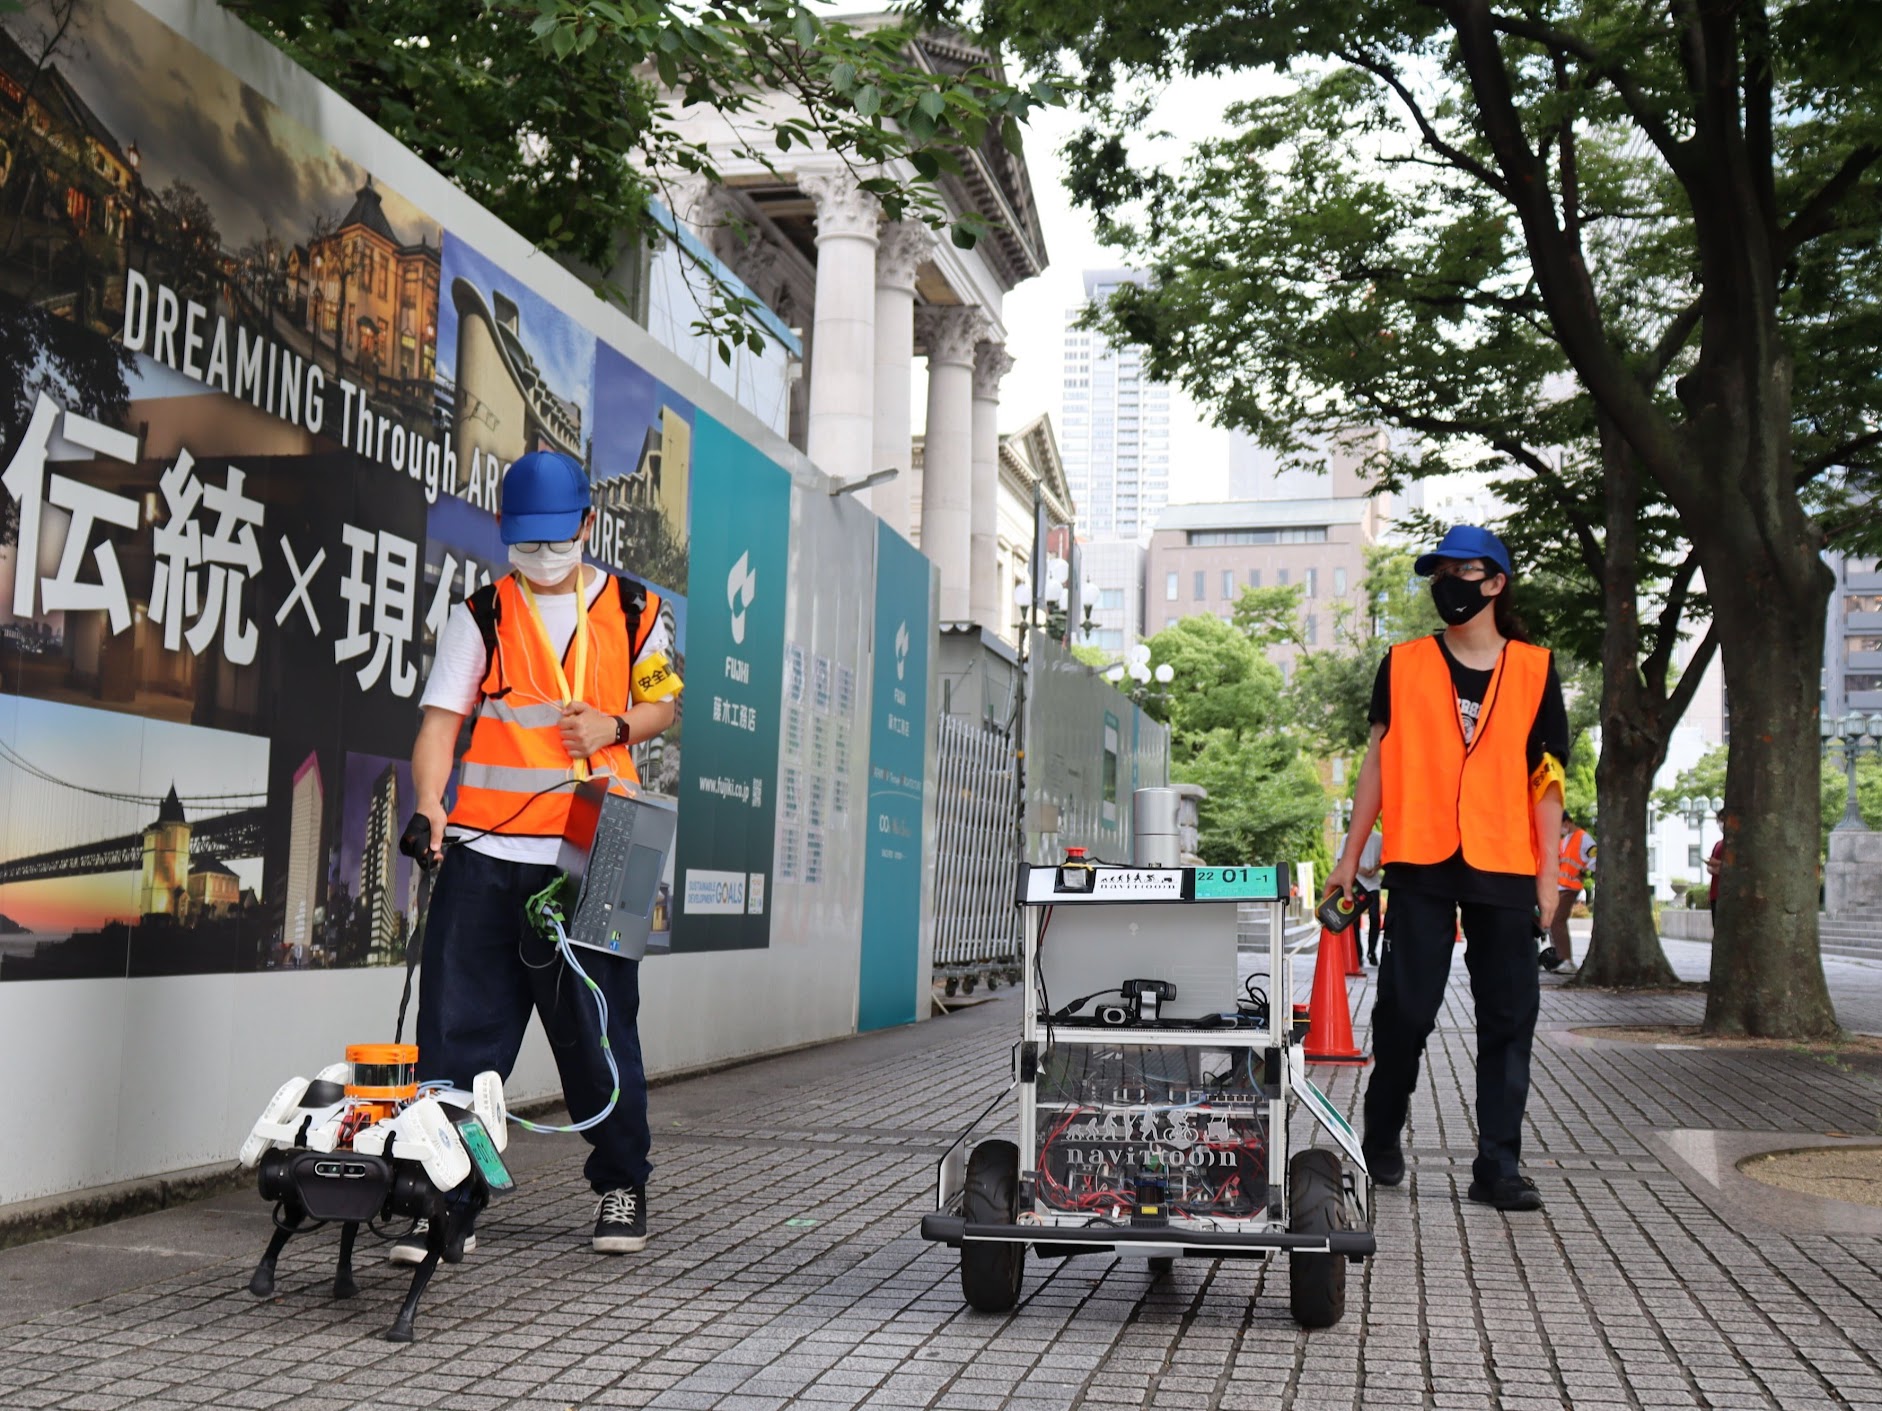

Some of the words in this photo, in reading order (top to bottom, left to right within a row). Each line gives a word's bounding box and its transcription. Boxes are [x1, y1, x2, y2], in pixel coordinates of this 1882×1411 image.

[123, 267, 325, 434] DREAMING
[340, 378, 457, 504] Through
[1197, 872, 1214, 881] 22
[1222, 869, 1248, 883] 01
[716, 881, 744, 905] GOALS
